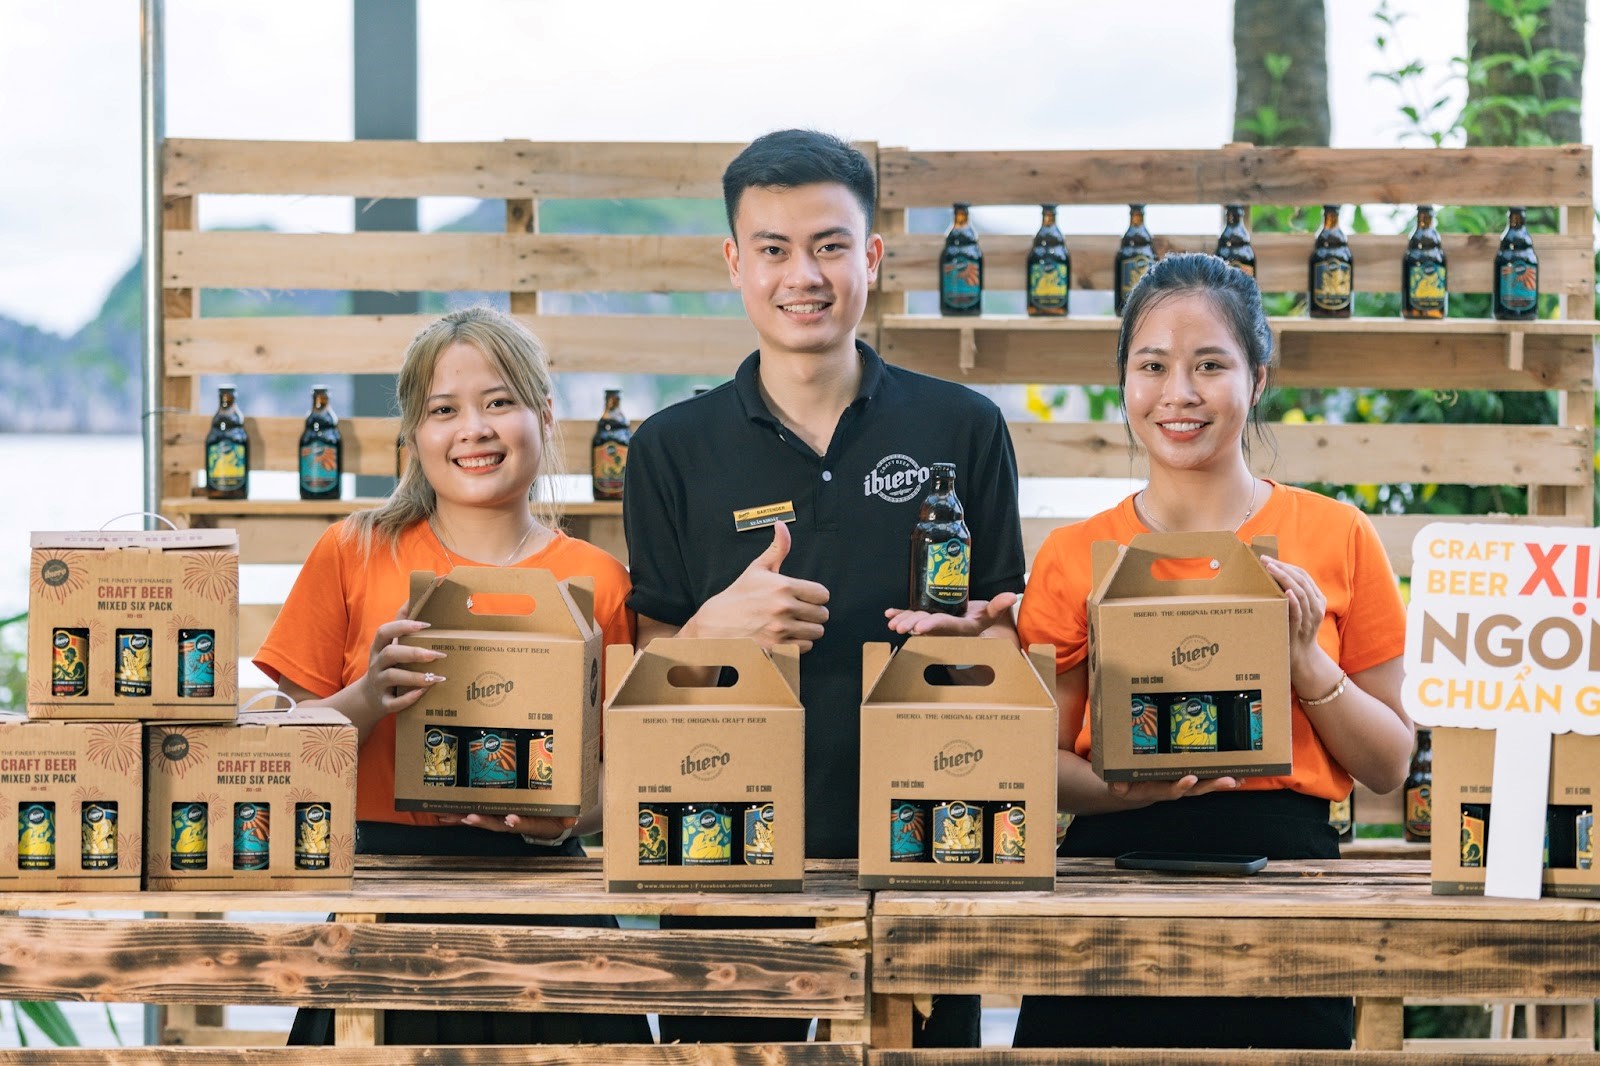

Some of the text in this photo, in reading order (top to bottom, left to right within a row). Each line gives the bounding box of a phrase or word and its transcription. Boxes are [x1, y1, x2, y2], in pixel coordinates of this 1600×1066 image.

[880, 460, 895, 474] CRAFT
[896, 460, 910, 468] BEER
[863, 466, 930, 497] ibiero
[757, 506, 786, 515] BARTENDER
[1428, 538, 1515, 562] CRAFT
[1426, 569, 1509, 597] BEER
[1518, 543, 1600, 616] XỊ
[98, 586, 173, 599] CRAFT BEER
[97, 601, 173, 611] MIXED SIX PACK
[1420, 609, 1600, 672] NGO
[1171, 643, 1220, 667] ibiero
[466, 680, 514, 702] ibiero
[1417, 665, 1563, 715] CHUẨN
[1, 759, 77, 771] CRAFT BEER
[217, 760, 291, 773] CRAFT BEER
[681, 752, 730, 775] ibiero
[934, 748, 984, 771] ibiero
[0, 774, 76, 783] MIXED SIX PACK
[217, 775, 291, 785] MIXED SIX PACK
